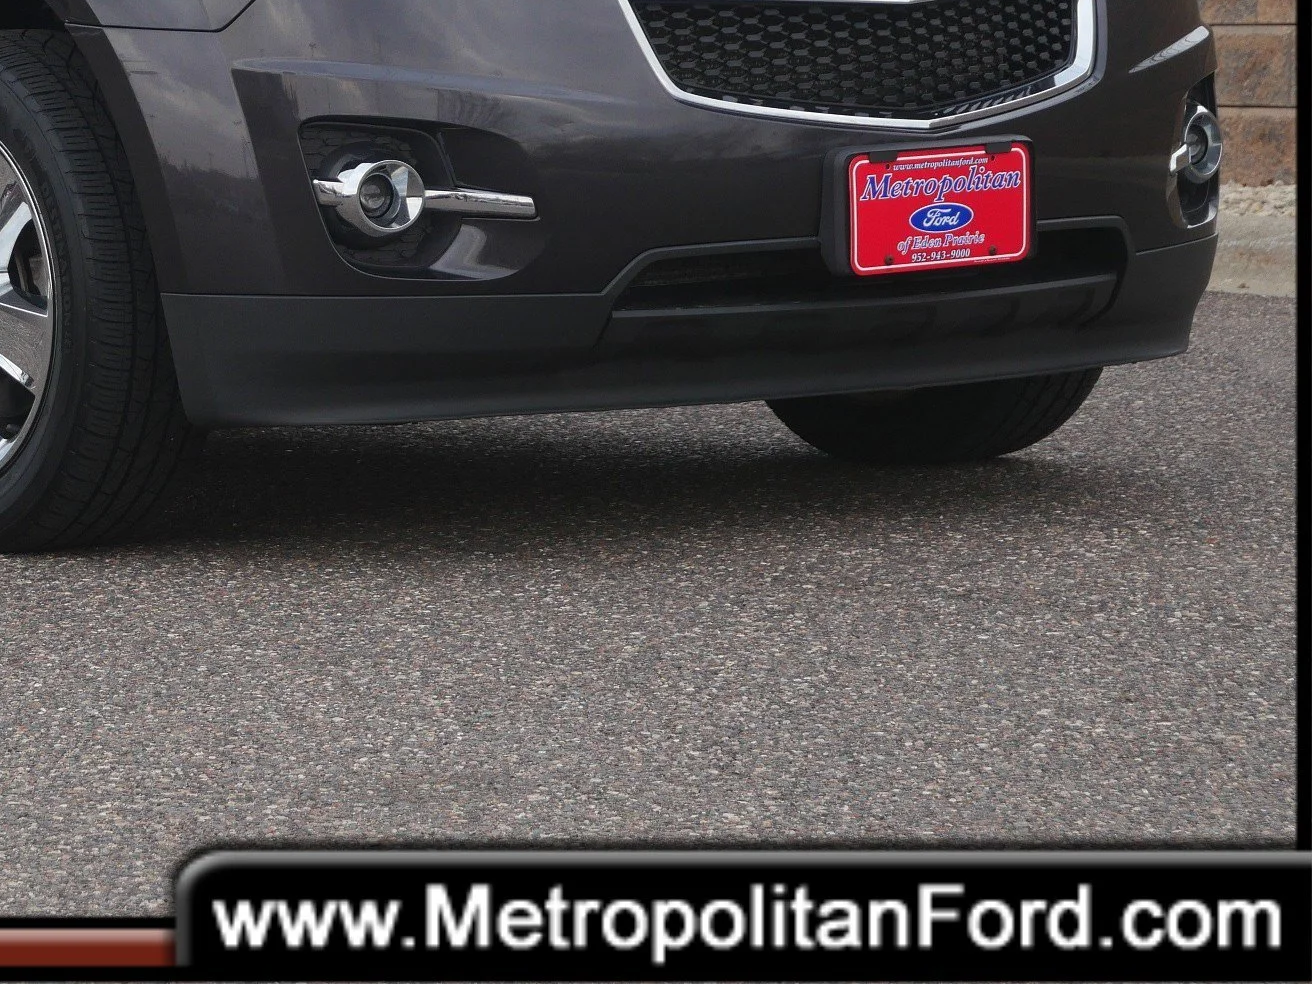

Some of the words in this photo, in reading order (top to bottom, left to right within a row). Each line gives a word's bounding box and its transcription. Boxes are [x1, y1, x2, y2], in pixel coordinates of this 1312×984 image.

[893, 157, 988, 171] www.metropolitanford.com
[860, 165, 1021, 202] Metropolitan
[922, 208, 960, 228] Ford
[897, 236, 912, 255] of
[911, 234, 942, 250] Eden
[942, 230, 986, 247] Prairie
[911, 248, 971, 263] 952-943-9000
